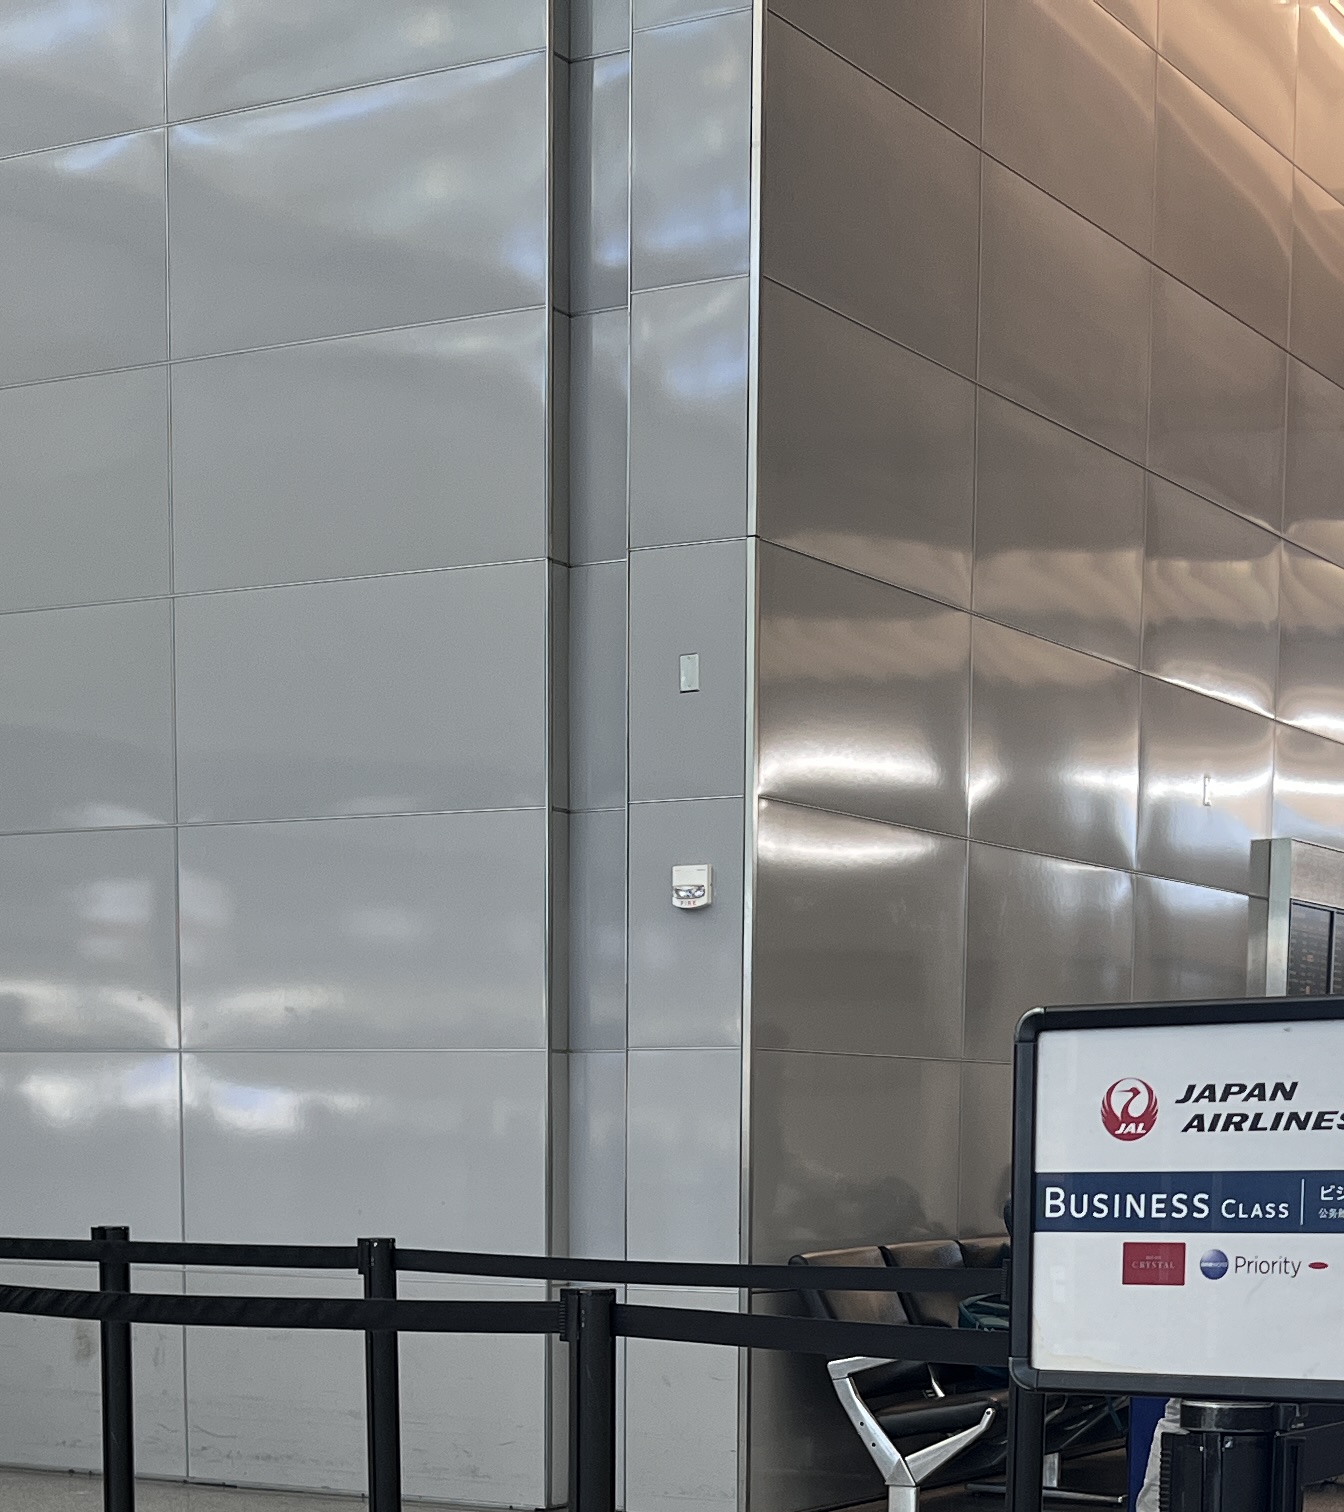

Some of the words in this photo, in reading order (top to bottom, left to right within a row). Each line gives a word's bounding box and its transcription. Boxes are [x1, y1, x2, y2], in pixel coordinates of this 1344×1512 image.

[1175, 1081, 1299, 1105] JAPAN
[1115, 1122, 1147, 1135] JAL
[1044, 1186, 1209, 1219] BUSINESS
[1221, 1199, 1291, 1219] CLASS
[1234, 1256, 1302, 1278] Priority
